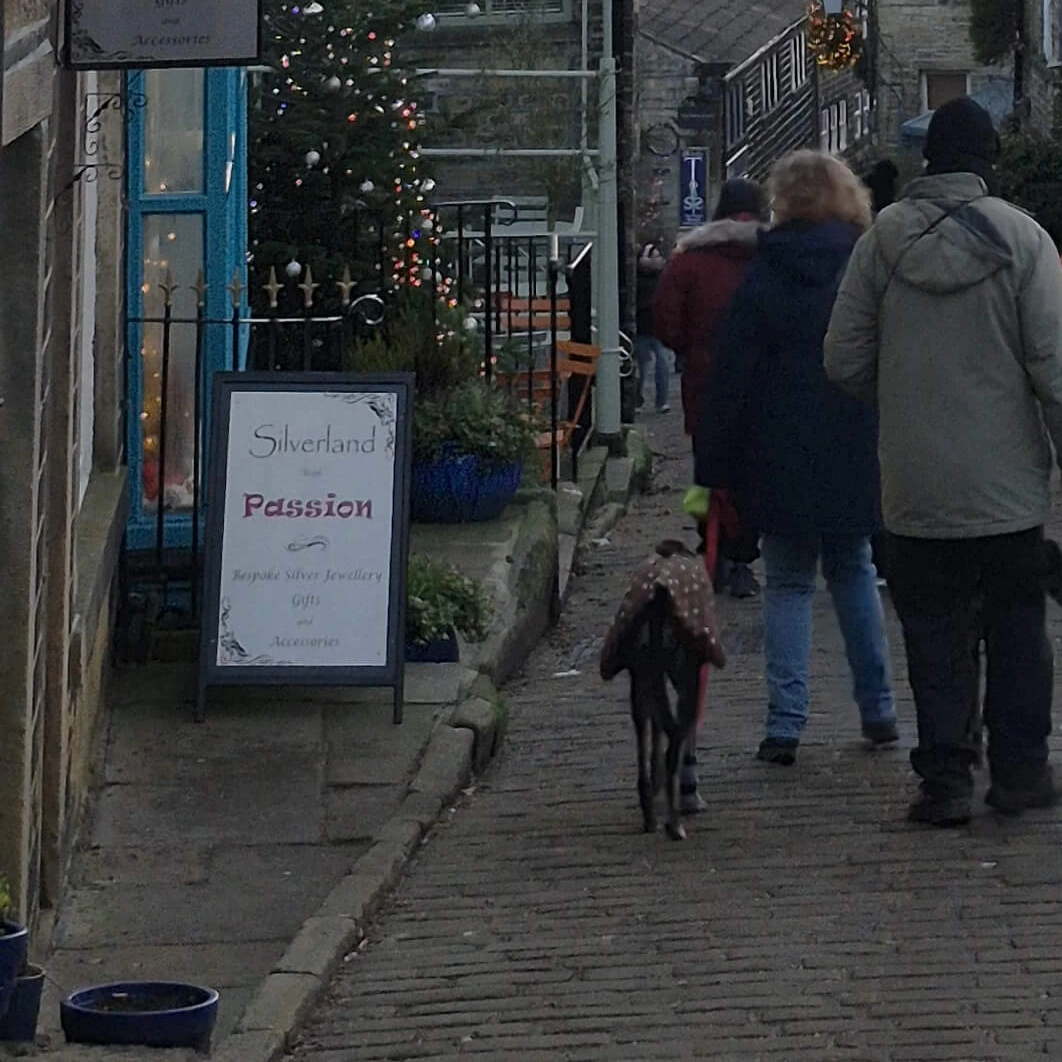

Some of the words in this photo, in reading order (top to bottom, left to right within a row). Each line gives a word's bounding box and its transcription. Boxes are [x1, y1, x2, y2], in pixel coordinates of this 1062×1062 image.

[248, 423, 376, 459] Silverland
[242, 492, 373, 519] Passion
[231, 568, 281, 585] Bespoke
[284, 568, 320, 582] Silver
[323, 568, 384, 585] Jewellery
[291, 593, 321, 609] Gifts
[270, 635, 340, 649] Accessories
